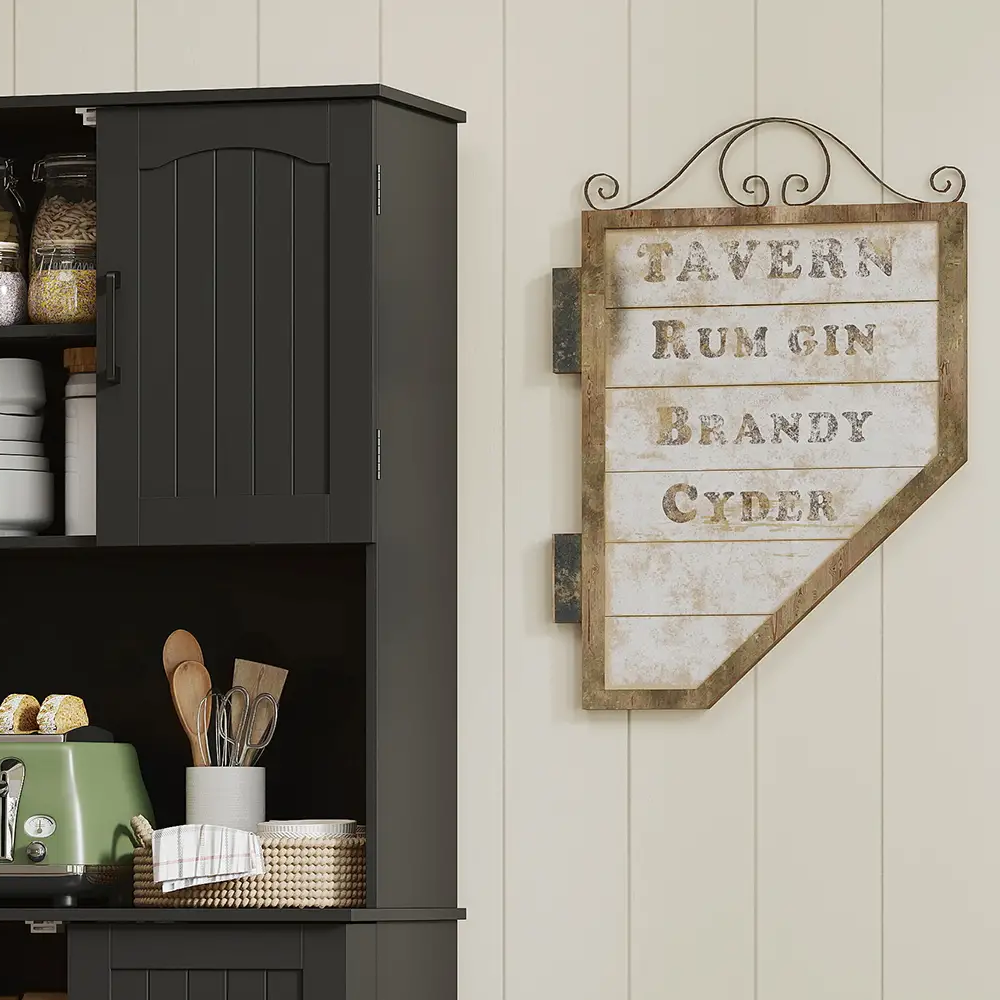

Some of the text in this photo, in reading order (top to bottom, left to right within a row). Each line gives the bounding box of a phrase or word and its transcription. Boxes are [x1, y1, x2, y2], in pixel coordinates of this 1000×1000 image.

[637, 236, 897, 283] TAVERN
[651, 319, 877, 360] RUM GIN
[655, 405, 874, 447] BRANDY
[661, 482, 836, 525] CYDER
